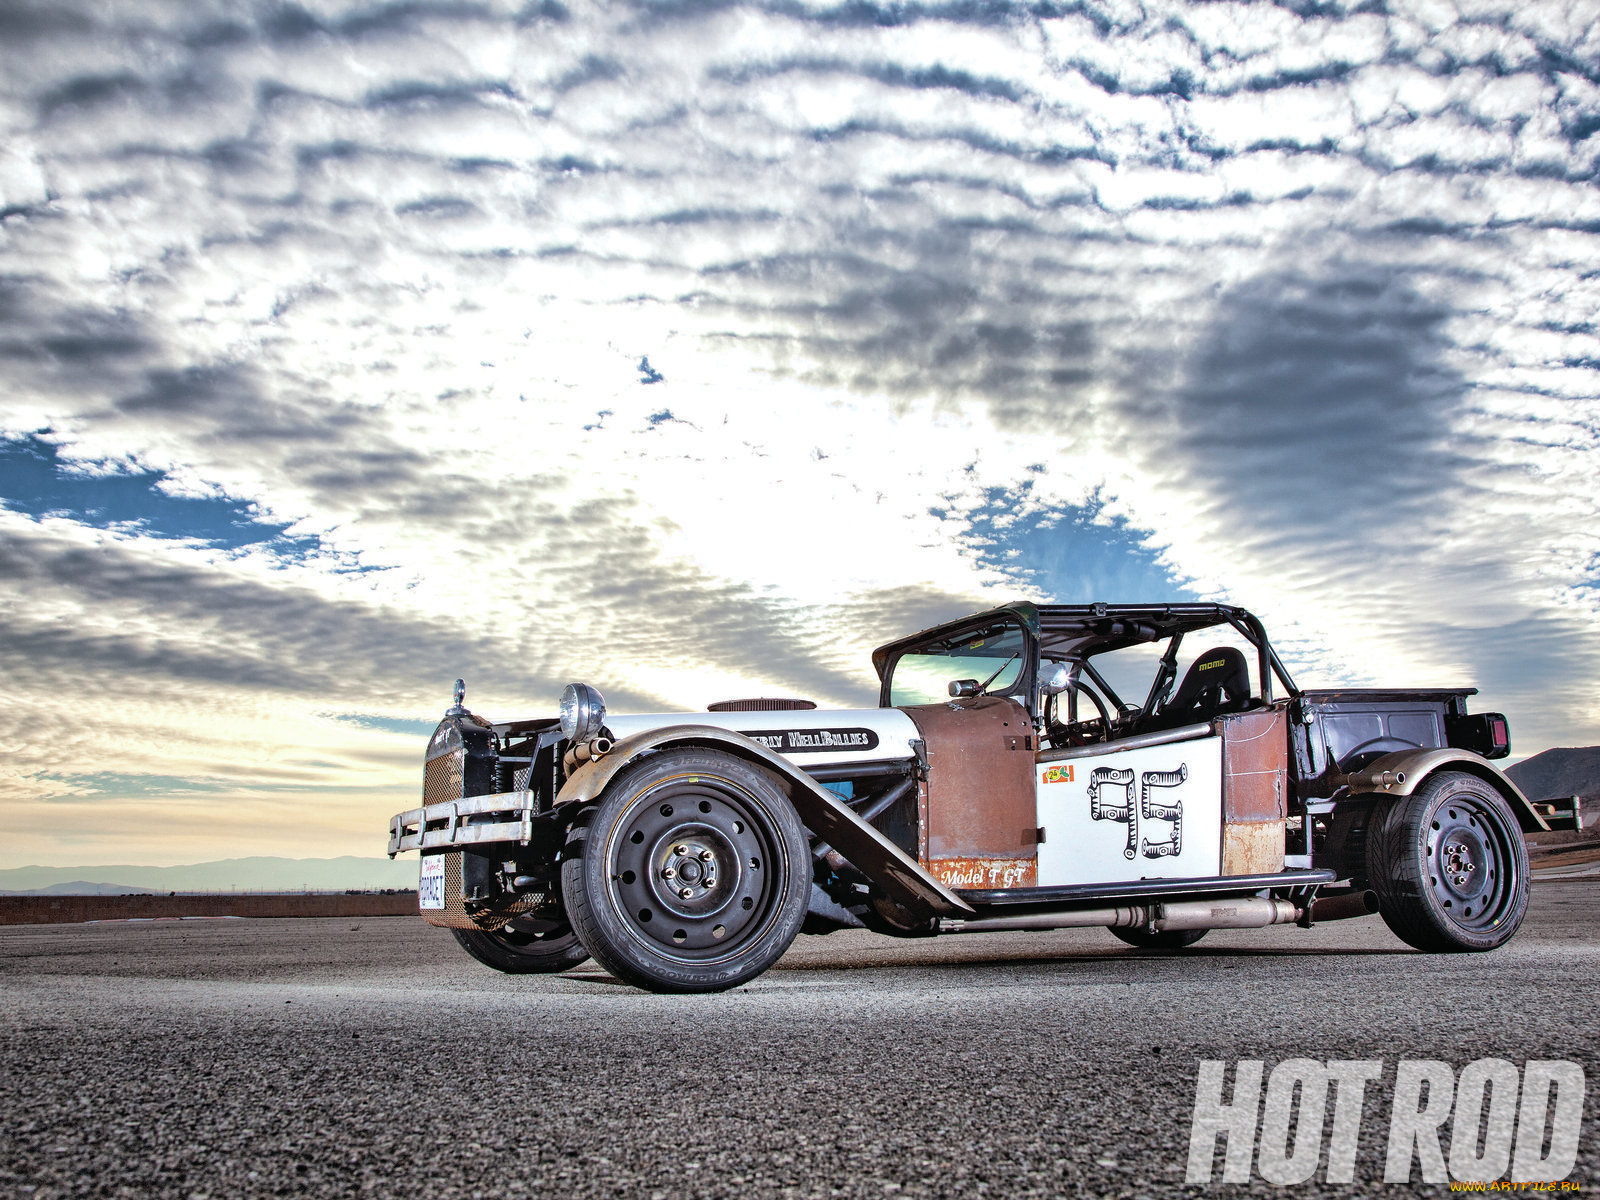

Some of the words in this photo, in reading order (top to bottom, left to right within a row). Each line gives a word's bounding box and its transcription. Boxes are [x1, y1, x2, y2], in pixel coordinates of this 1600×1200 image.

[941, 869, 984, 885] Model
[988, 869, 1001, 884] T
[1003, 868, 1026, 889] GT
